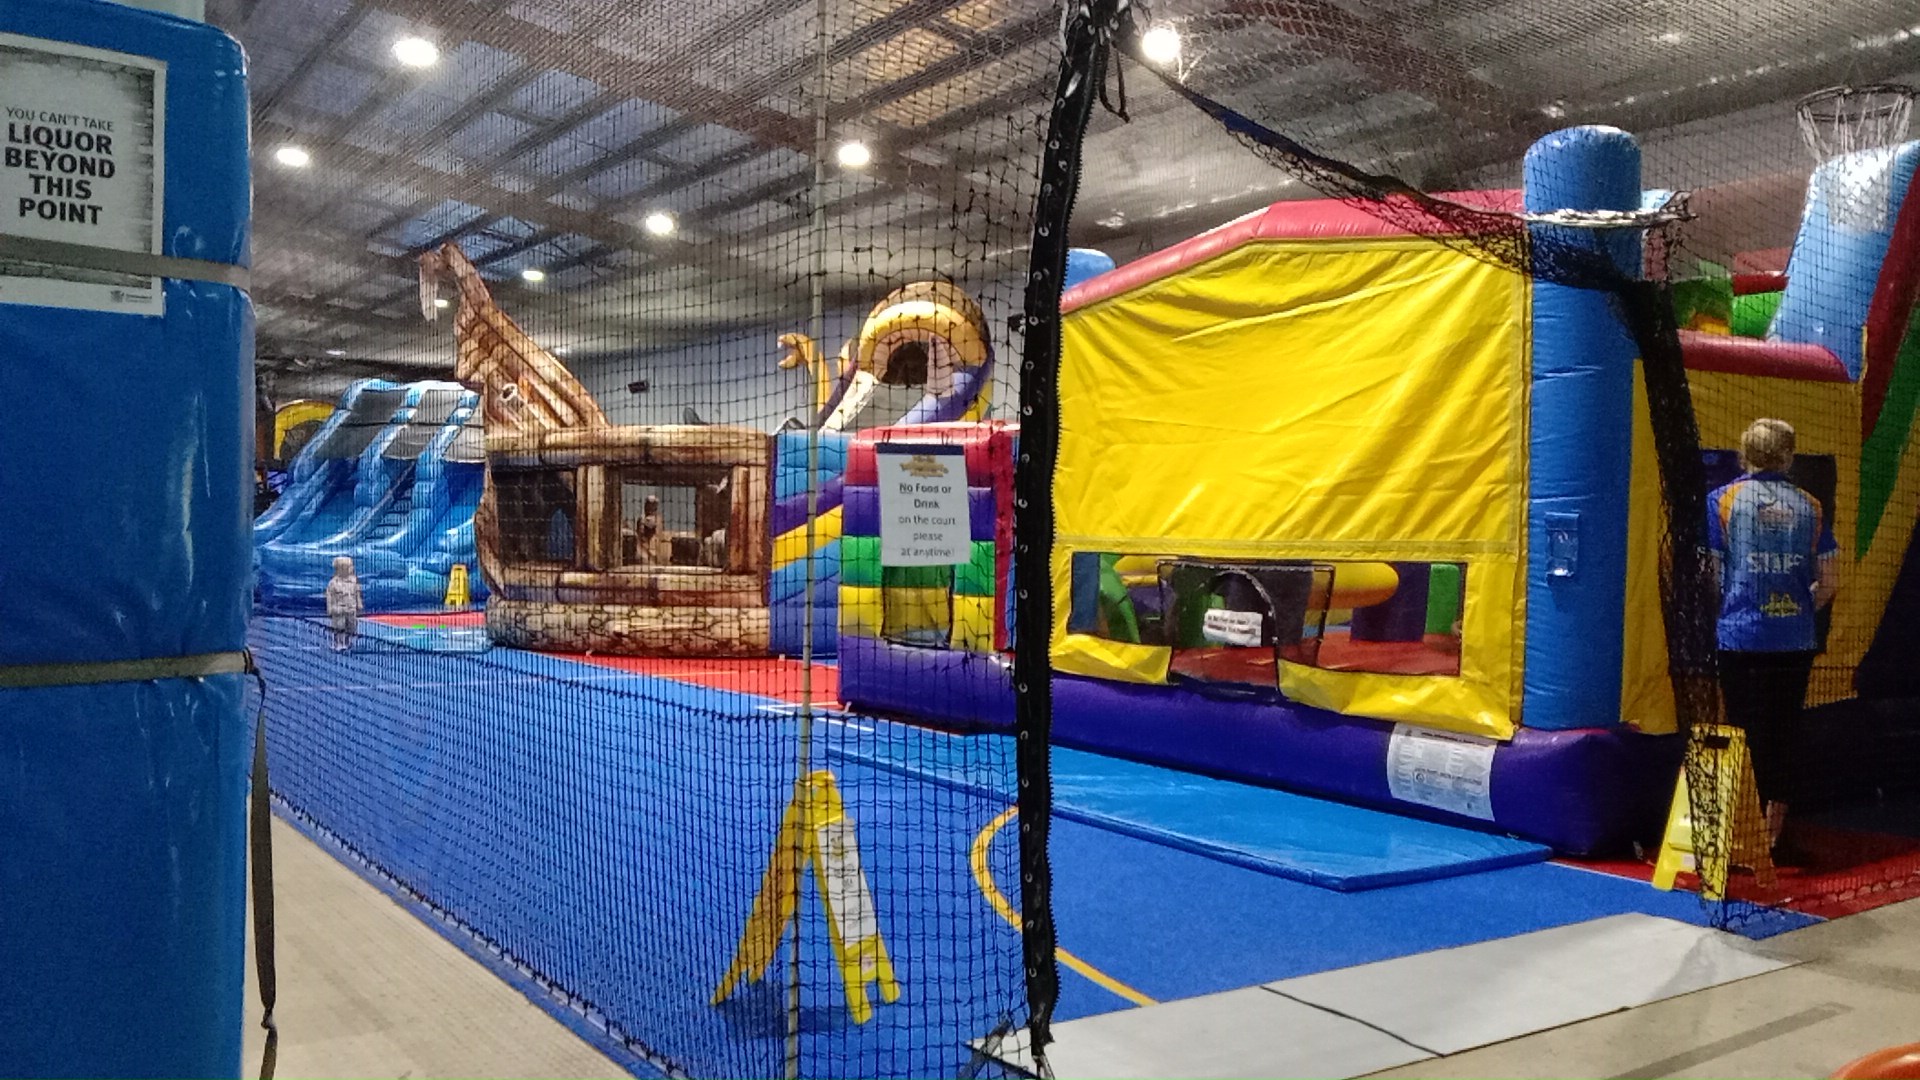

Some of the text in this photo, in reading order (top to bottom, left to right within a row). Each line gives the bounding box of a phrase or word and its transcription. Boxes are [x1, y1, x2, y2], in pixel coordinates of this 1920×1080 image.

[6, 106, 114, 132] YOU CAN'T TAKE
[8, 122, 113, 155] LIQUOR
[5, 146, 116, 179] BEYOND
[29, 173, 92, 200] THIS
[19, 197, 103, 225] POINT
[899, 482, 952, 494] No Food or
[914, 499, 940, 509] Drink
[899, 515, 956, 526] on the court
[913, 532, 943, 542] please
[901, 547, 911, 557] at
